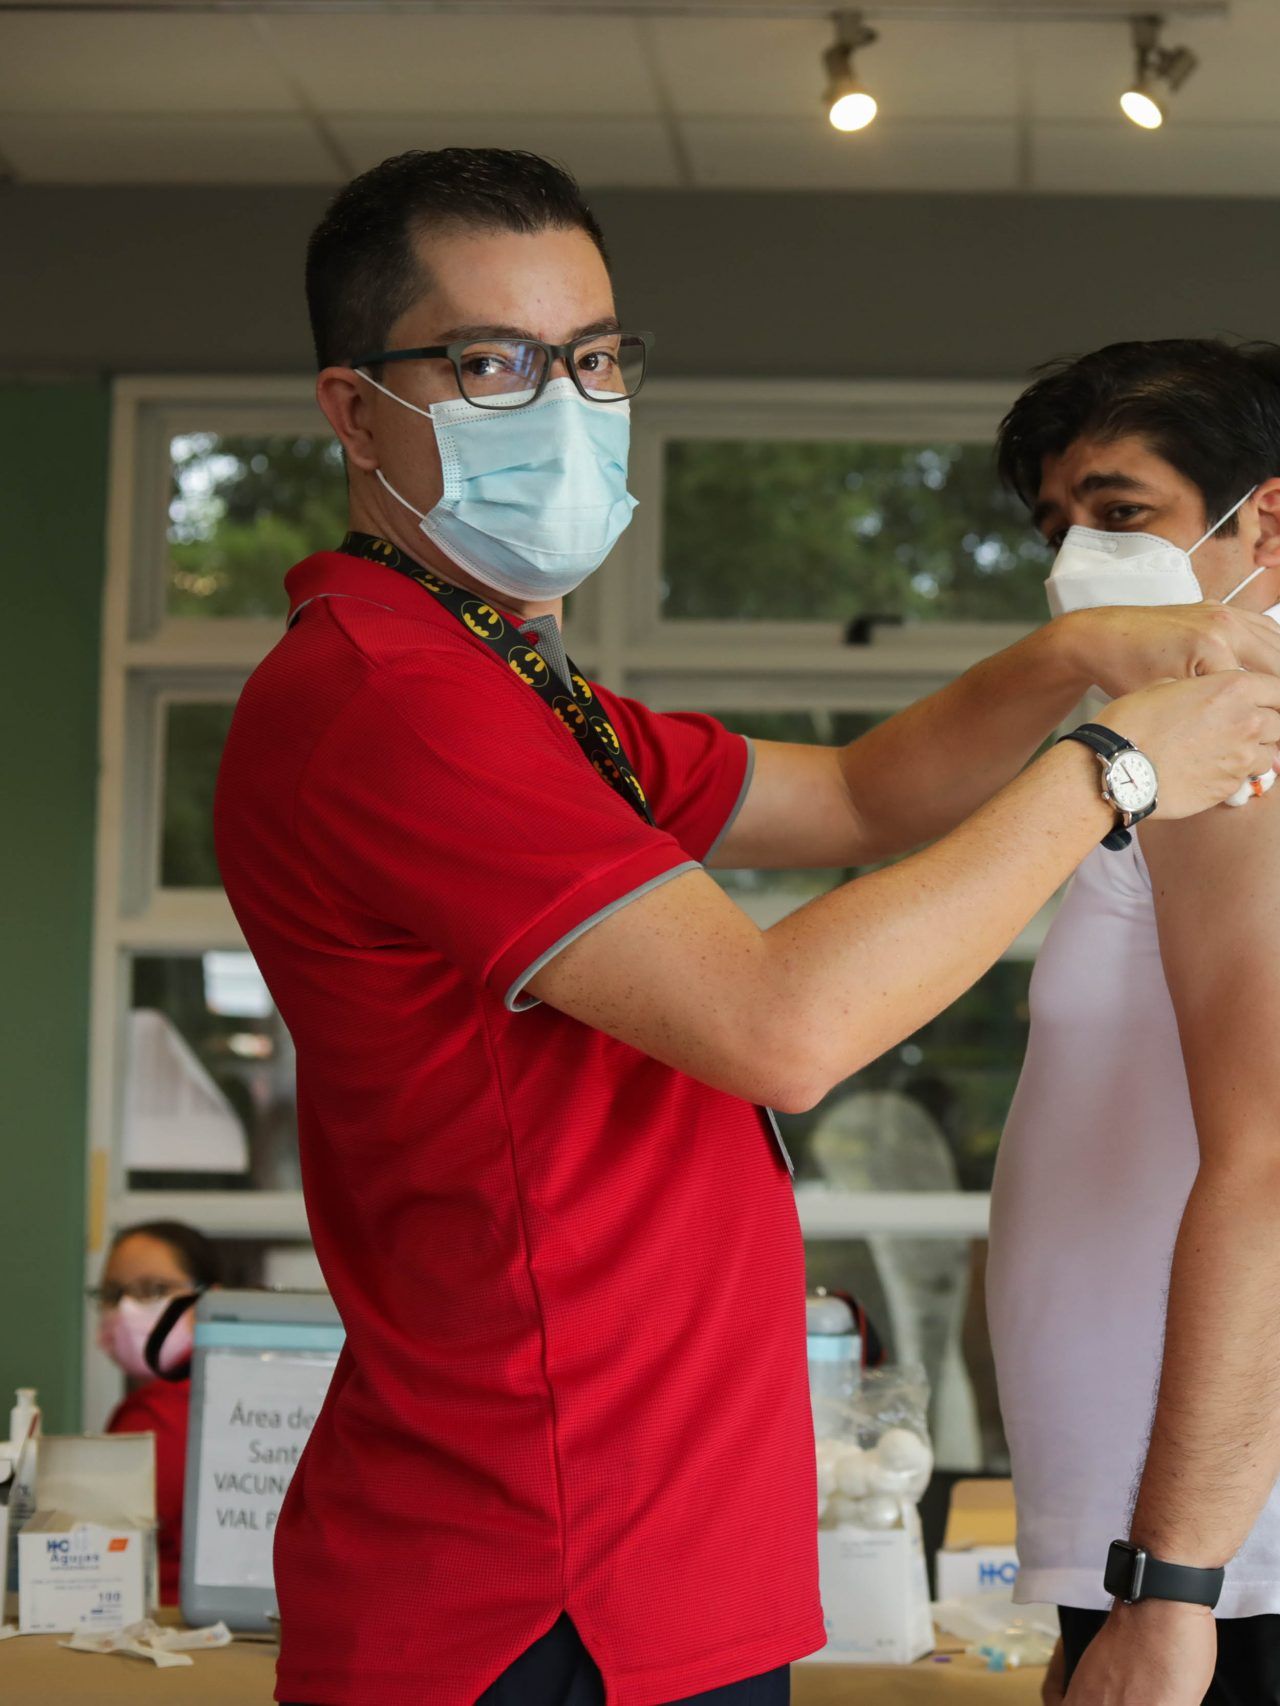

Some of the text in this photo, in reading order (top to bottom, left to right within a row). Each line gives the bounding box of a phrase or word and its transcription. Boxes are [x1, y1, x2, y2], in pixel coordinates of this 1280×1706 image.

[287, 1406, 314, 1431] de
[249, 1440, 299, 1466] Sant
[214, 1473, 284, 1495] VACUN
[216, 1508, 260, 1531] VIAL
